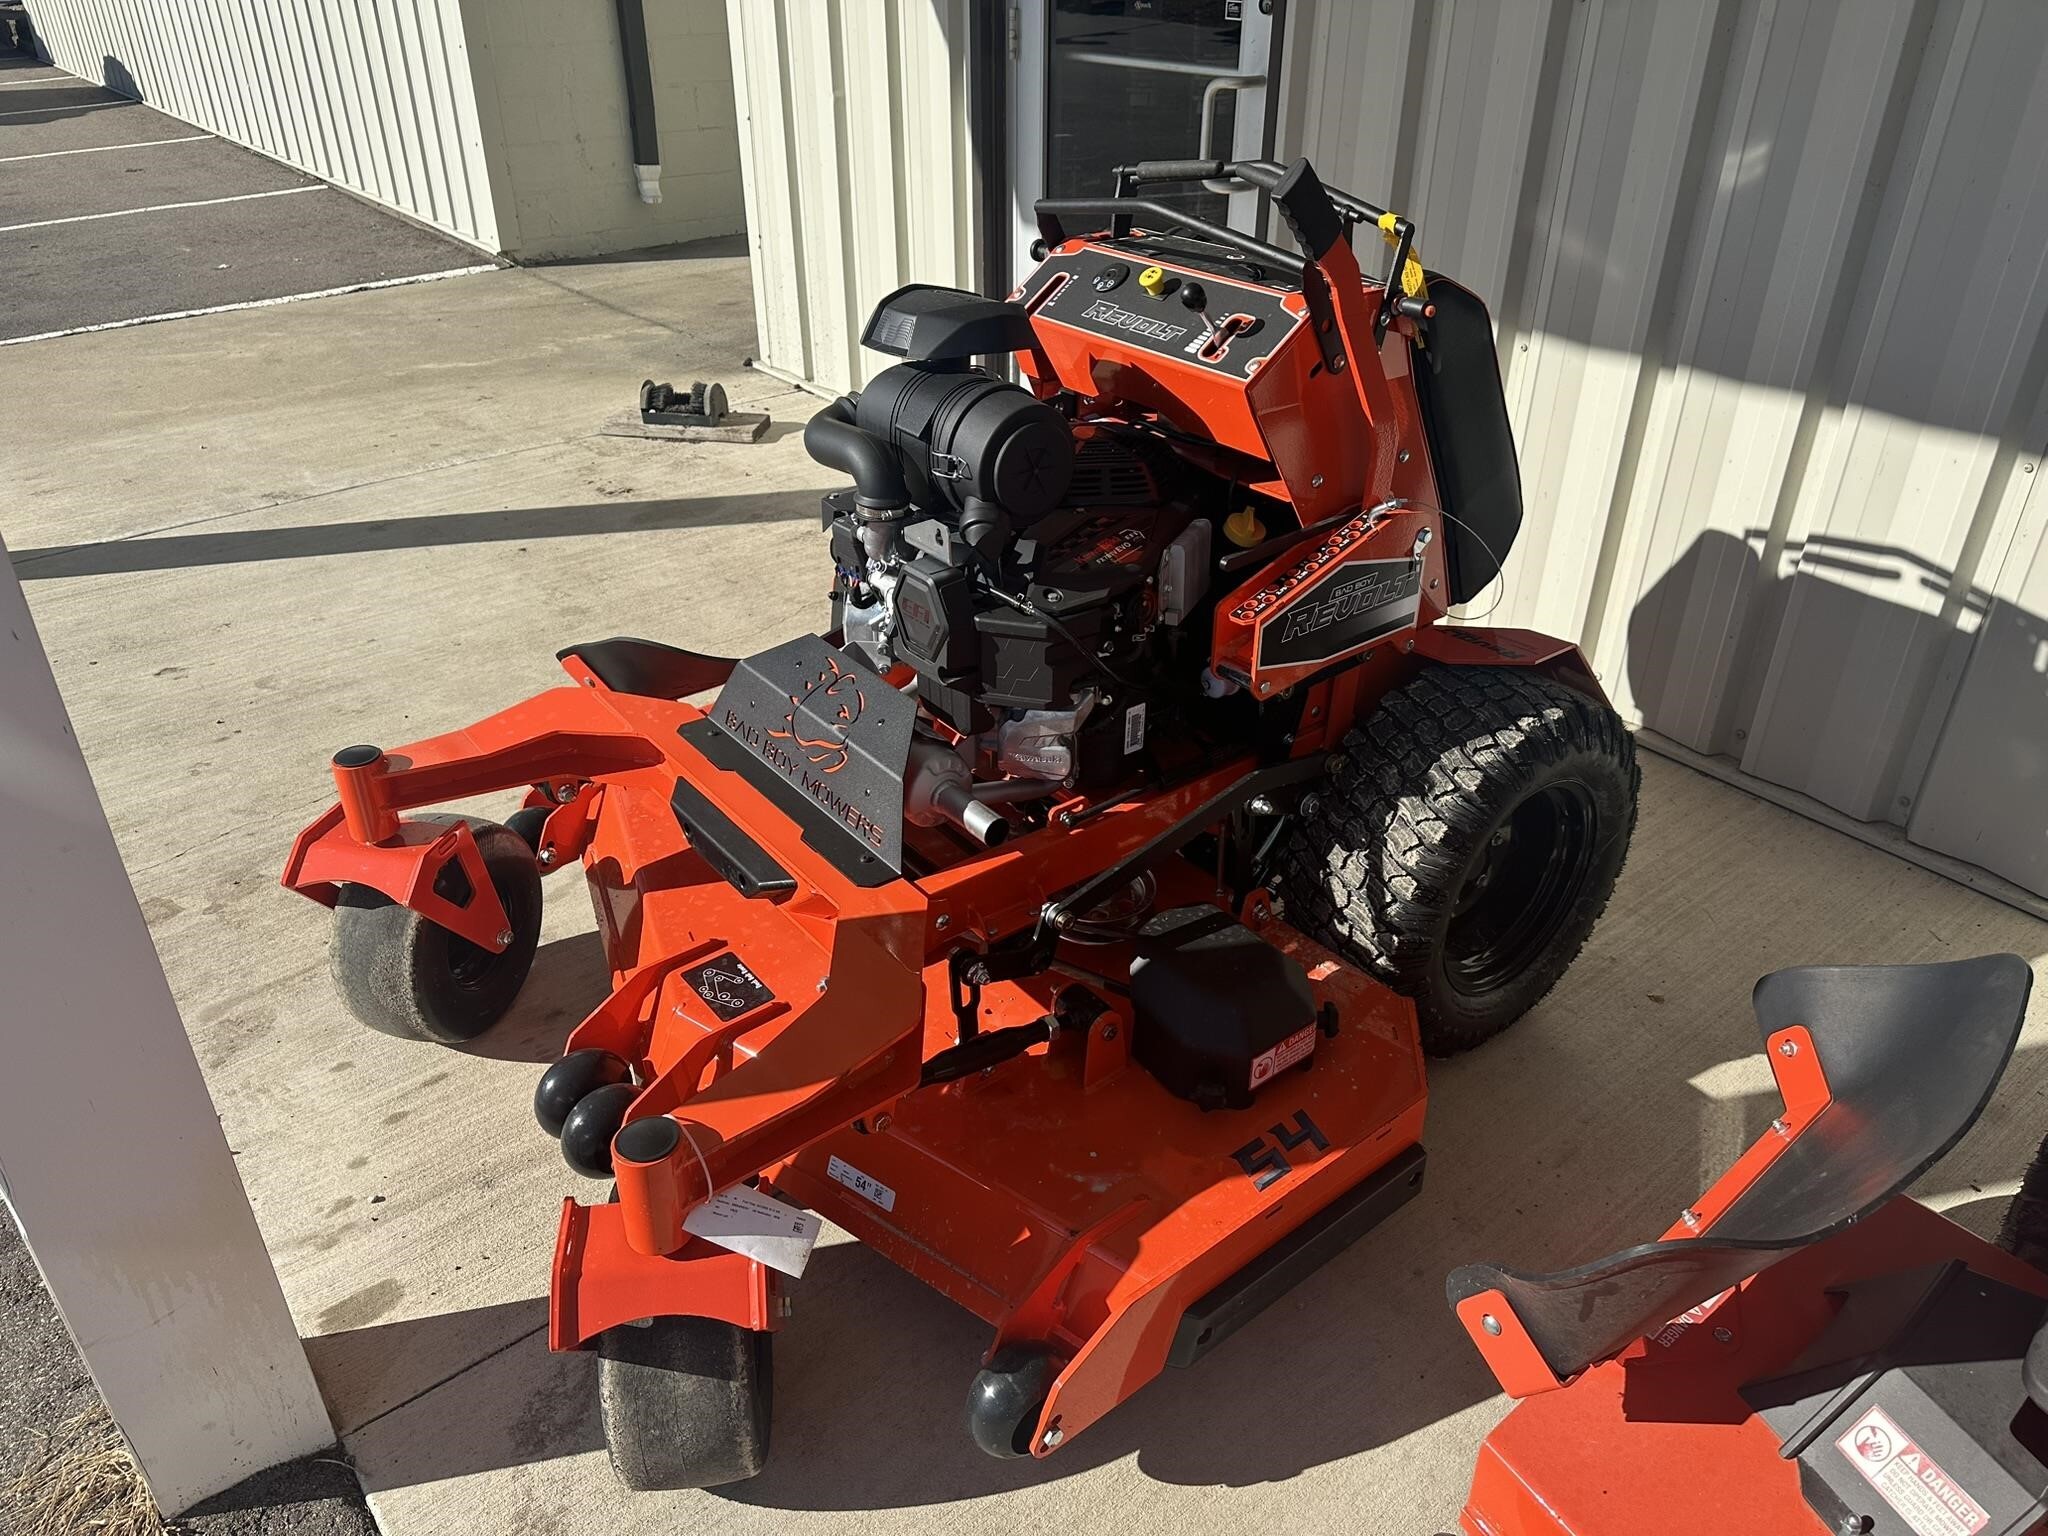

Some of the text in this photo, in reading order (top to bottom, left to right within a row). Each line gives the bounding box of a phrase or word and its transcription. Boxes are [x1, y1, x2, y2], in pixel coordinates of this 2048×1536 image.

[1082, 299, 1188, 342] REVOLT
[1281, 572, 1416, 643] REVOLT
[1335, 578, 1374, 597] BAD BOY
[725, 709, 886, 848] BAD BOY MOWERS
[1229, 1108, 1331, 1192] 54
[1658, 1314, 1695, 1348] DANGER
[1880, 1481, 1906, 1508] CATCHER
[1882, 1472, 1904, 1495] UNLESS
[1903, 1493, 1924, 1515] GUARD
[1893, 1461, 1909, 1477] KEEP
[1907, 1475, 1928, 1496] HANDS
[1919, 1466, 1980, 1528] DANGER
[1909, 1488, 1935, 1515] OPERATE
